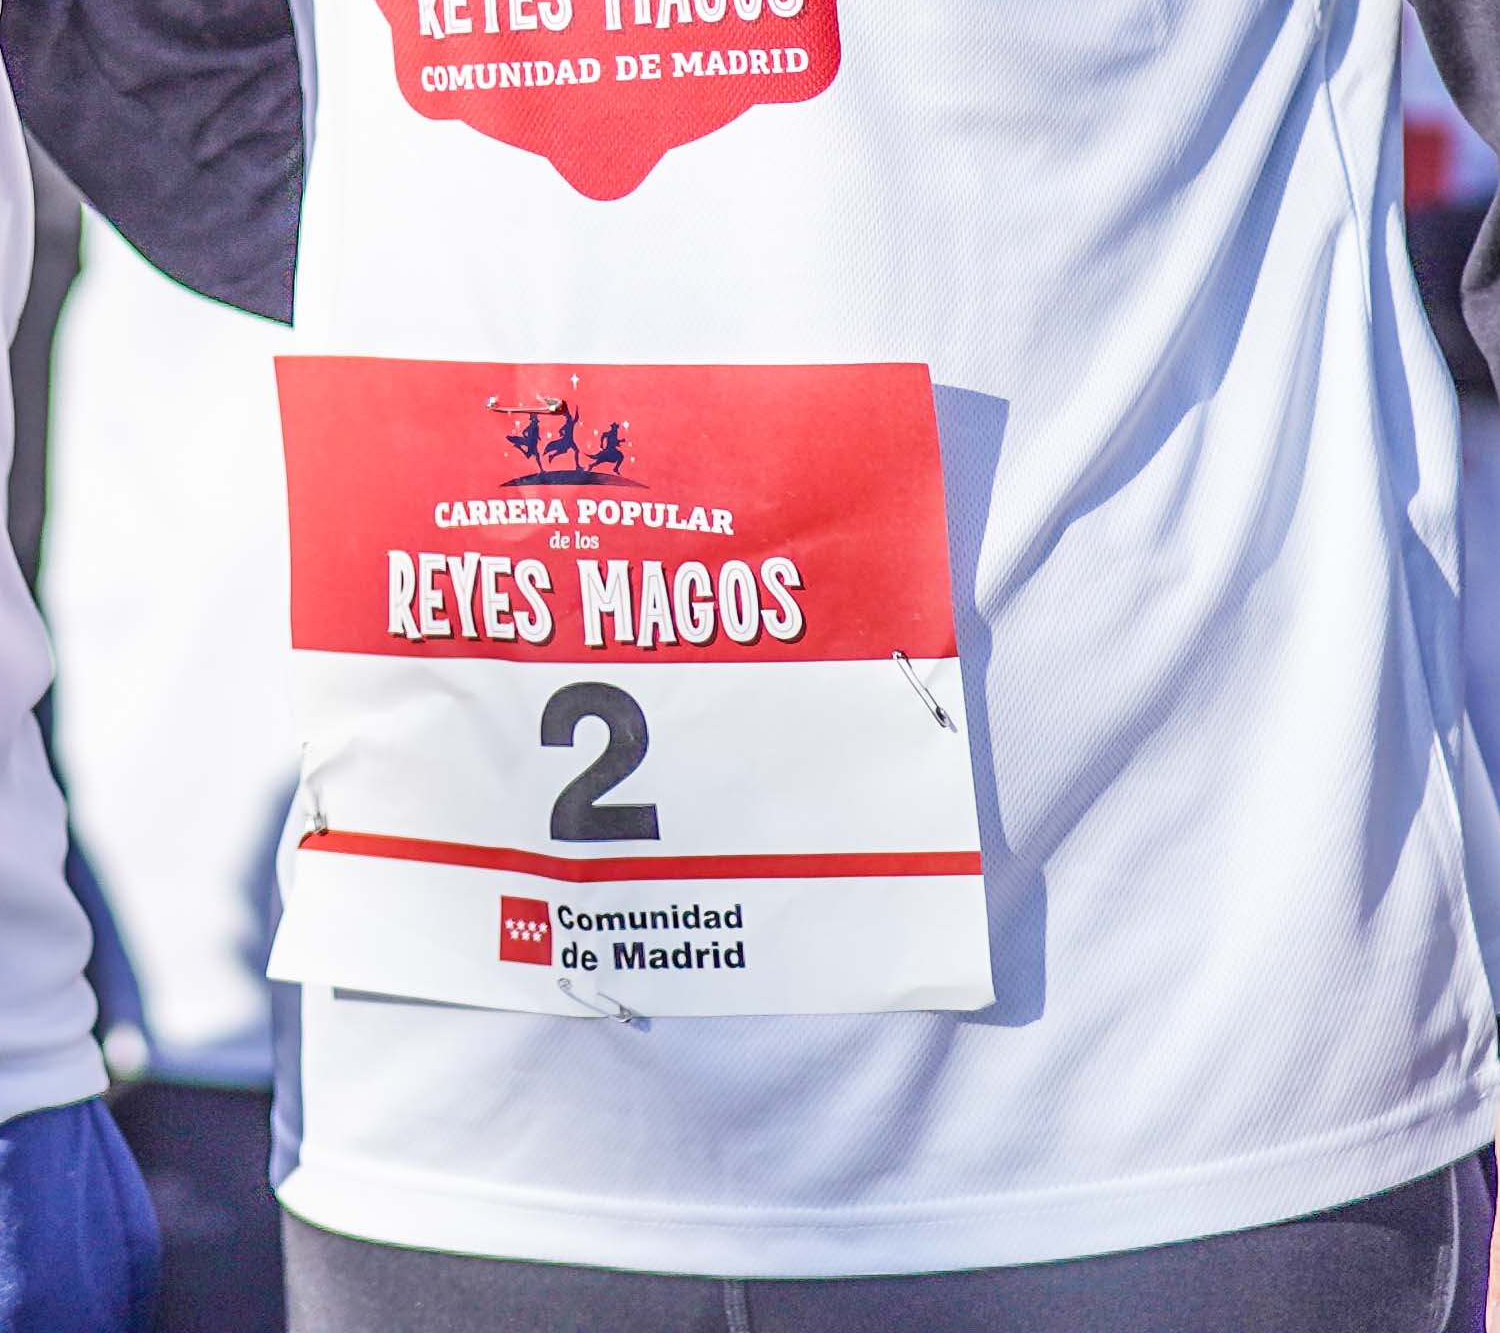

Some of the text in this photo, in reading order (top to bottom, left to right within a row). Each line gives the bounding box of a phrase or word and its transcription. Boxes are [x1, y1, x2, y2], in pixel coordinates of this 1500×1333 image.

[420, 47, 810, 93] COMUNIDAD DE MADRID
[434, 500, 734, 535] CARRERA POPULAR
[549, 533, 600, 550] de los
[387, 551, 804, 648] REYES MAGOS
[540, 681, 661, 841] 2
[557, 903, 744, 932] Comunidad
[561, 940, 746, 972] de Madrid
